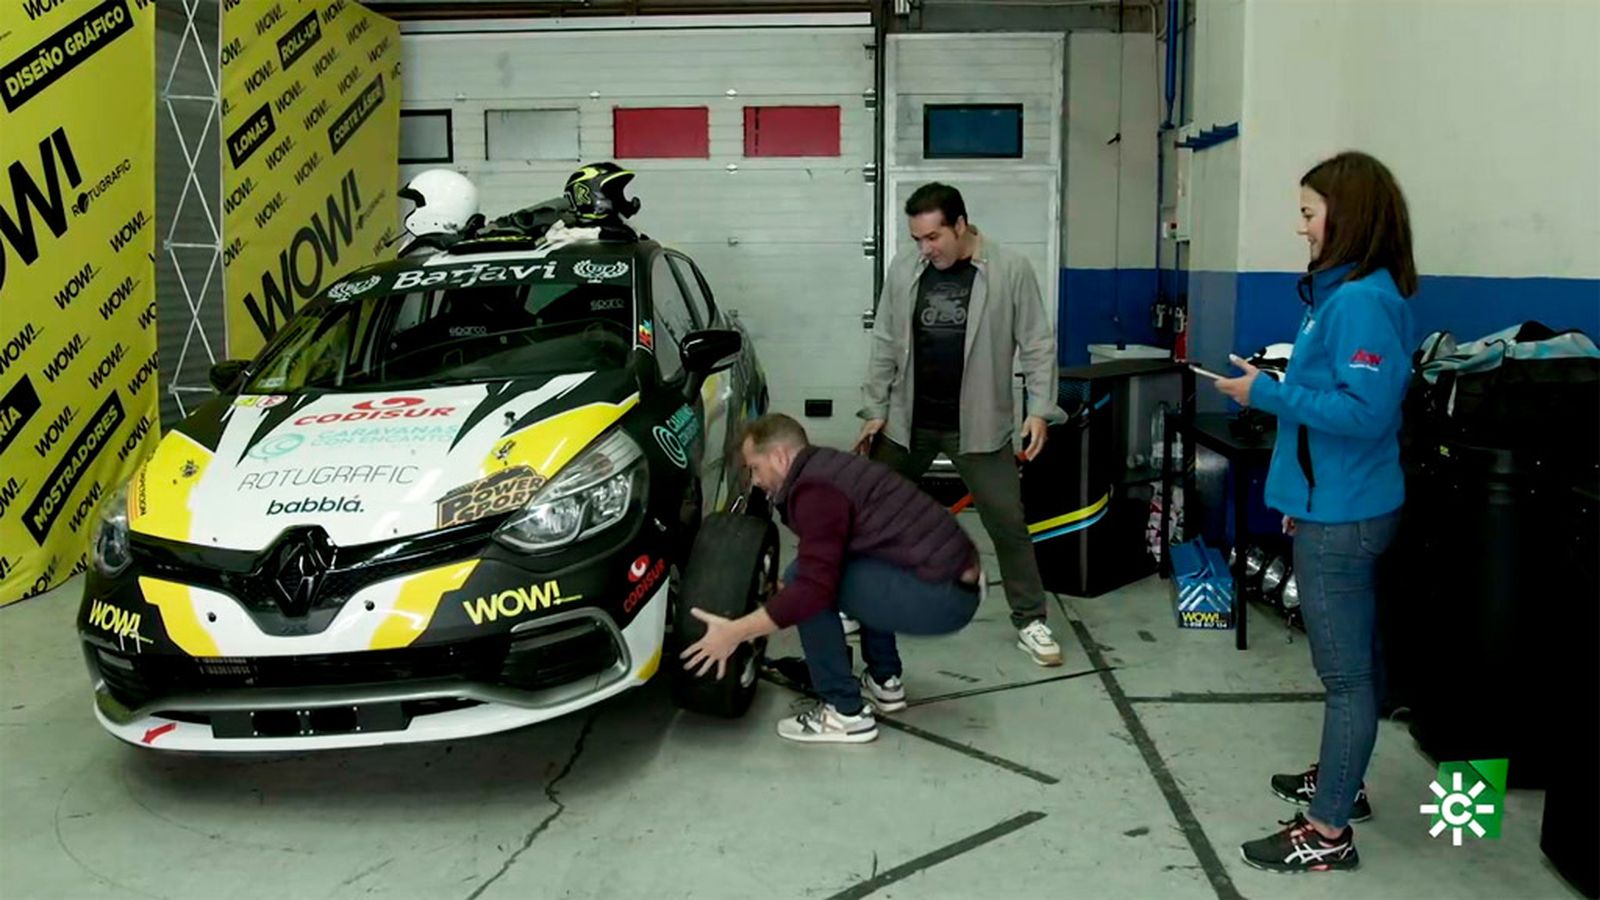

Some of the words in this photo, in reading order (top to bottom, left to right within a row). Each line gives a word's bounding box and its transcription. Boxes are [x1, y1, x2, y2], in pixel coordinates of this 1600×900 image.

[255, 4, 283, 36] WOW!
[281, 20, 318, 62] ROLL-UP
[5, 47, 64, 97] DISEÑO
[65, 6, 124, 56] GRÁFICO
[244, 60, 273, 94] WOW!
[233, 115, 269, 158] LONAS
[71, 158, 131, 217] ROTUGRAFIC
[223, 177, 254, 215] WOW!
[110, 210, 146, 253] WOW!
[243, 169, 361, 343] WOW!
[54, 262, 94, 310] WOW!
[99, 276, 134, 320] WOW!
[43, 333, 83, 382] WOW!
[88, 342, 123, 390] WOW!
[34, 405, 74, 457] WOW!
[294, 406, 456, 426] CODISUR
[317, 424, 459, 439] CARAVANAS
[311, 437, 351, 447] CON
[33, 404, 118, 531] MOSTRADORES
[237, 465, 419, 492] ROTUGRAFIC
[68, 480, 102, 533] WOW!
[266, 494, 365, 516] babblá.
[442, 477, 542, 527] POWER
[463, 580, 561, 625] WOW!
[623, 558, 665, 613] CODISUR
[89, 599, 141, 639] WOW!
[1182, 612, 1219, 623] WOW!
